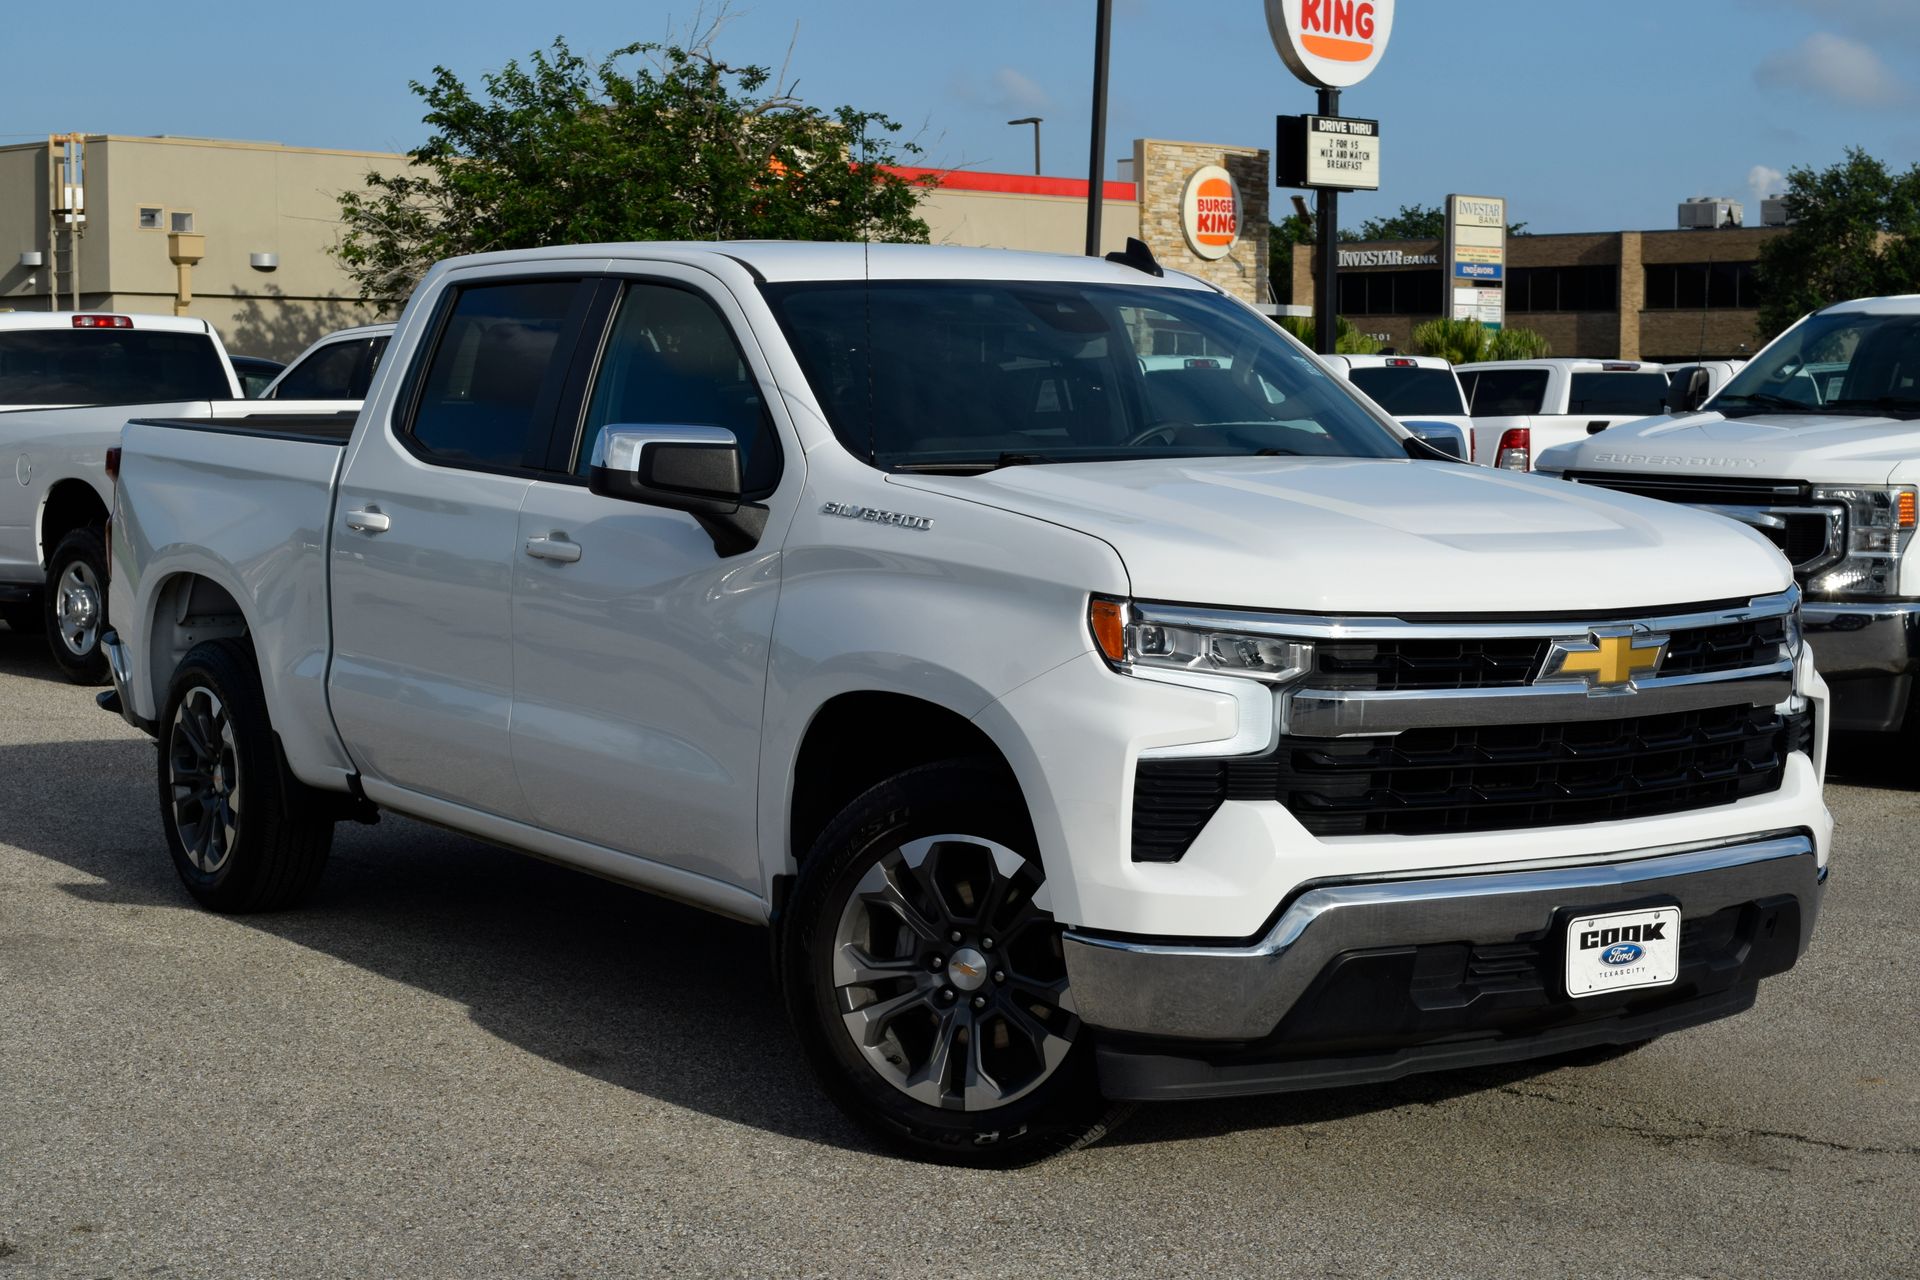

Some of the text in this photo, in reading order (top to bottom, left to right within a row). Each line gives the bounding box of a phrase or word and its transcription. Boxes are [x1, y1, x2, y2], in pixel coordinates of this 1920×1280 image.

[1301, 0, 1374, 39] KING
[1319, 120, 1372, 135] DRIVE THRU
[1336, 139, 1347, 149] FOR
[1320, 149, 1370, 161] MIX AND MATCH
[1327, 160, 1362, 170] BREAKFAST
[1197, 199, 1236, 213] BURGER
[1459, 200, 1500, 217] INVESTAR
[1197, 213, 1236, 233] KING
[1478, 216, 1500, 224] BANK
[1337, 249, 1439, 267] INVESTAR BANK
[1366, 333, 1390, 341] 501
[1594, 453, 1765, 467] SUPER DUTY
[823, 502, 935, 531] SILVERADO
[1580, 921, 1667, 950] COOK
[1608, 946, 1635, 963] Ford
[1599, 967, 1646, 978] TEXAS CITY
